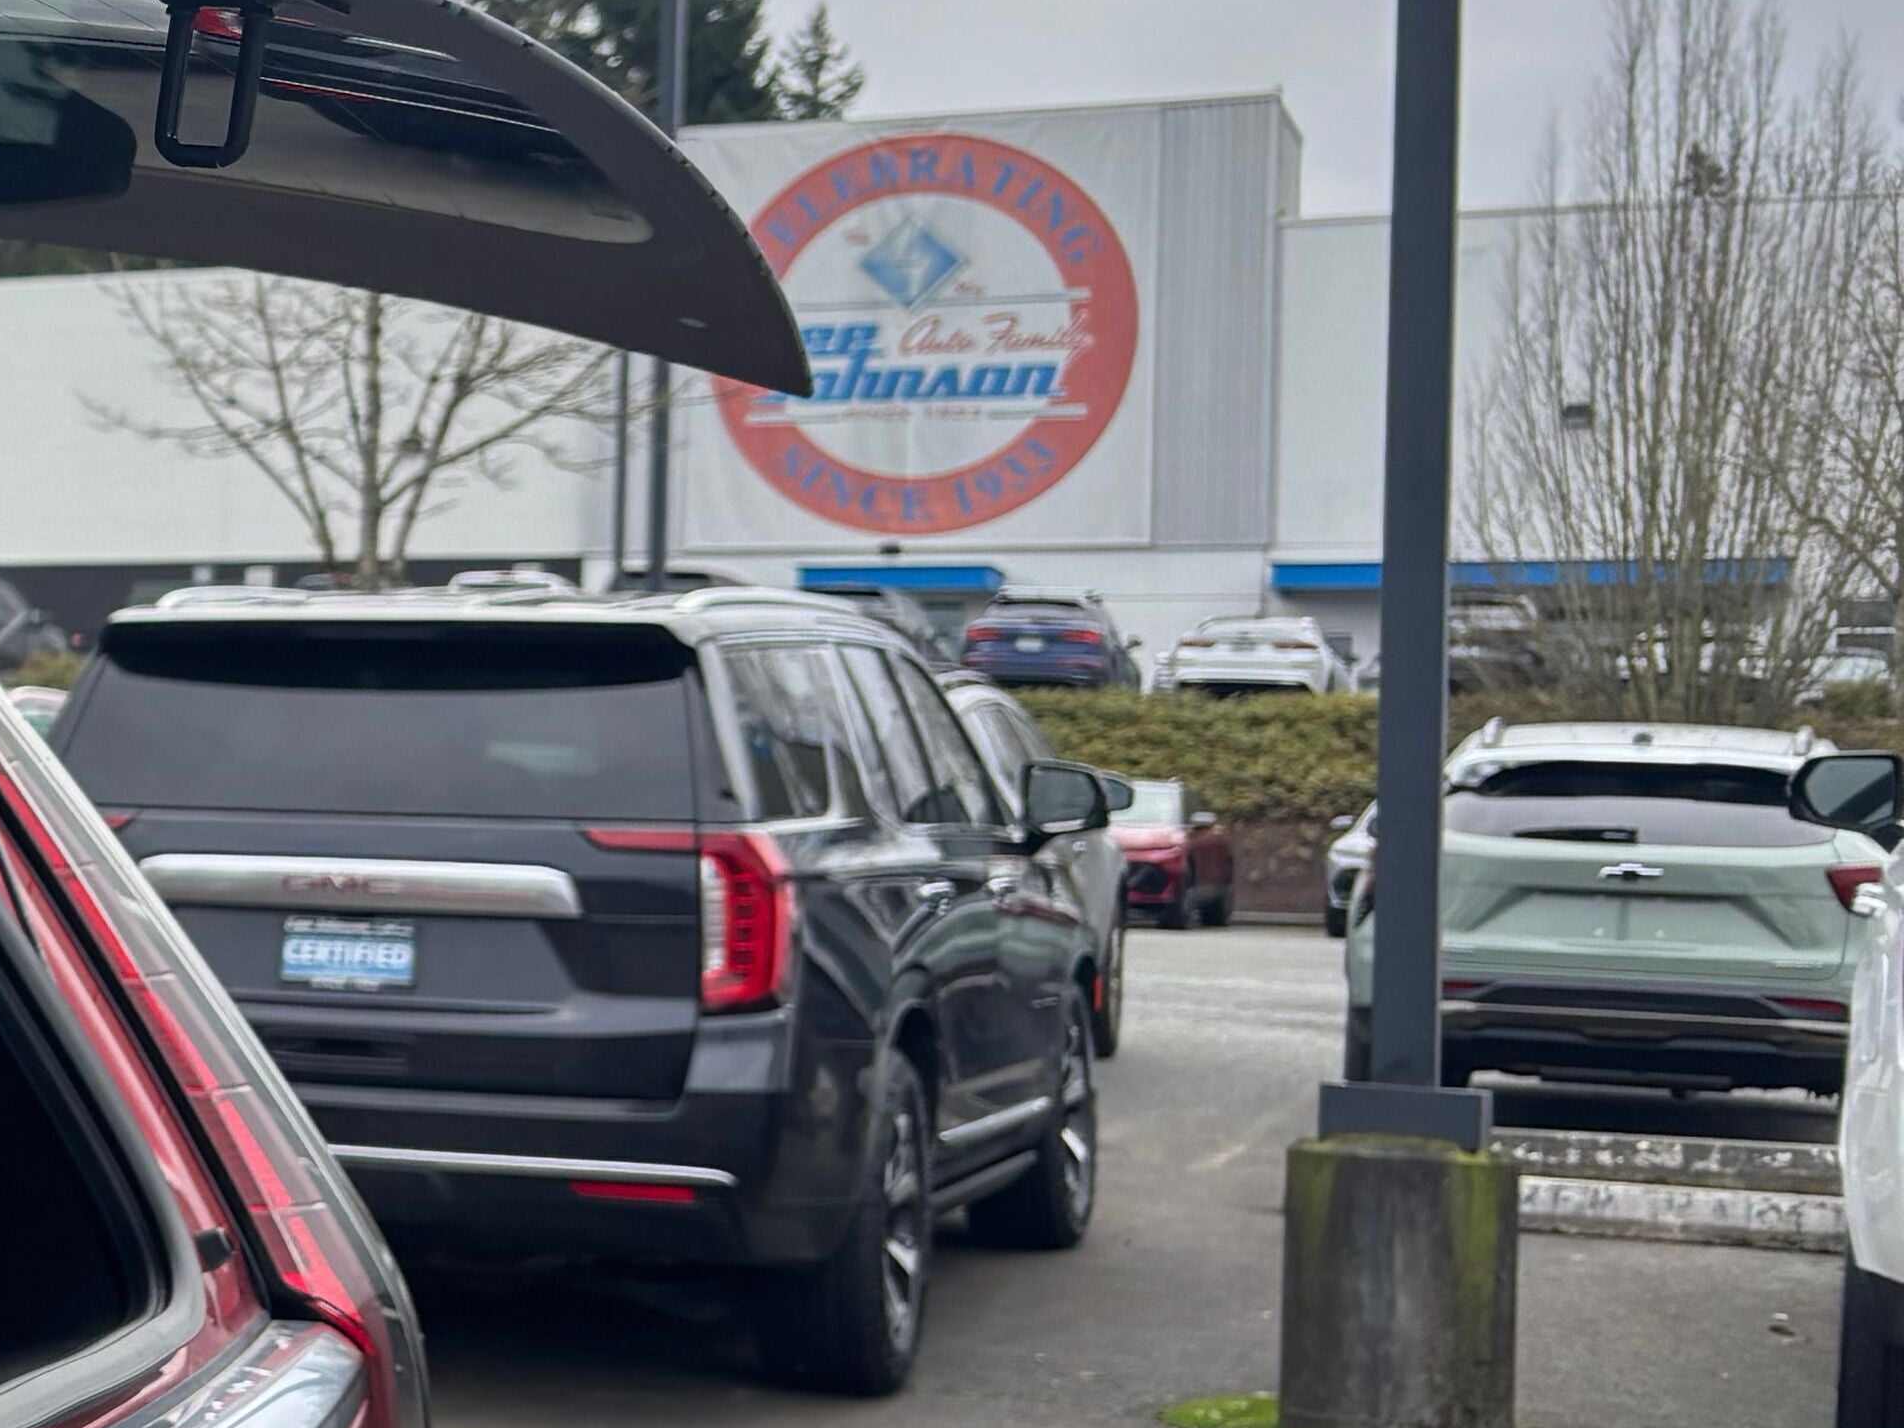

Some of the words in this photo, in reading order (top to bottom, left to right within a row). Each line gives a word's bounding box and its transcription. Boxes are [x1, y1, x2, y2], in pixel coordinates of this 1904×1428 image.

[765, 145, 1108, 268] ELEBRATING
[800, 324, 882, 361] ee
[898, 314, 977, 357] Auto
[980, 308, 1096, 363] Family
[754, 345, 1068, 405] ohnson
[772, 442, 934, 522] SINCE
[952, 438, 1056, 515] 1933
[282, 937, 415, 970] CERTIFIED
